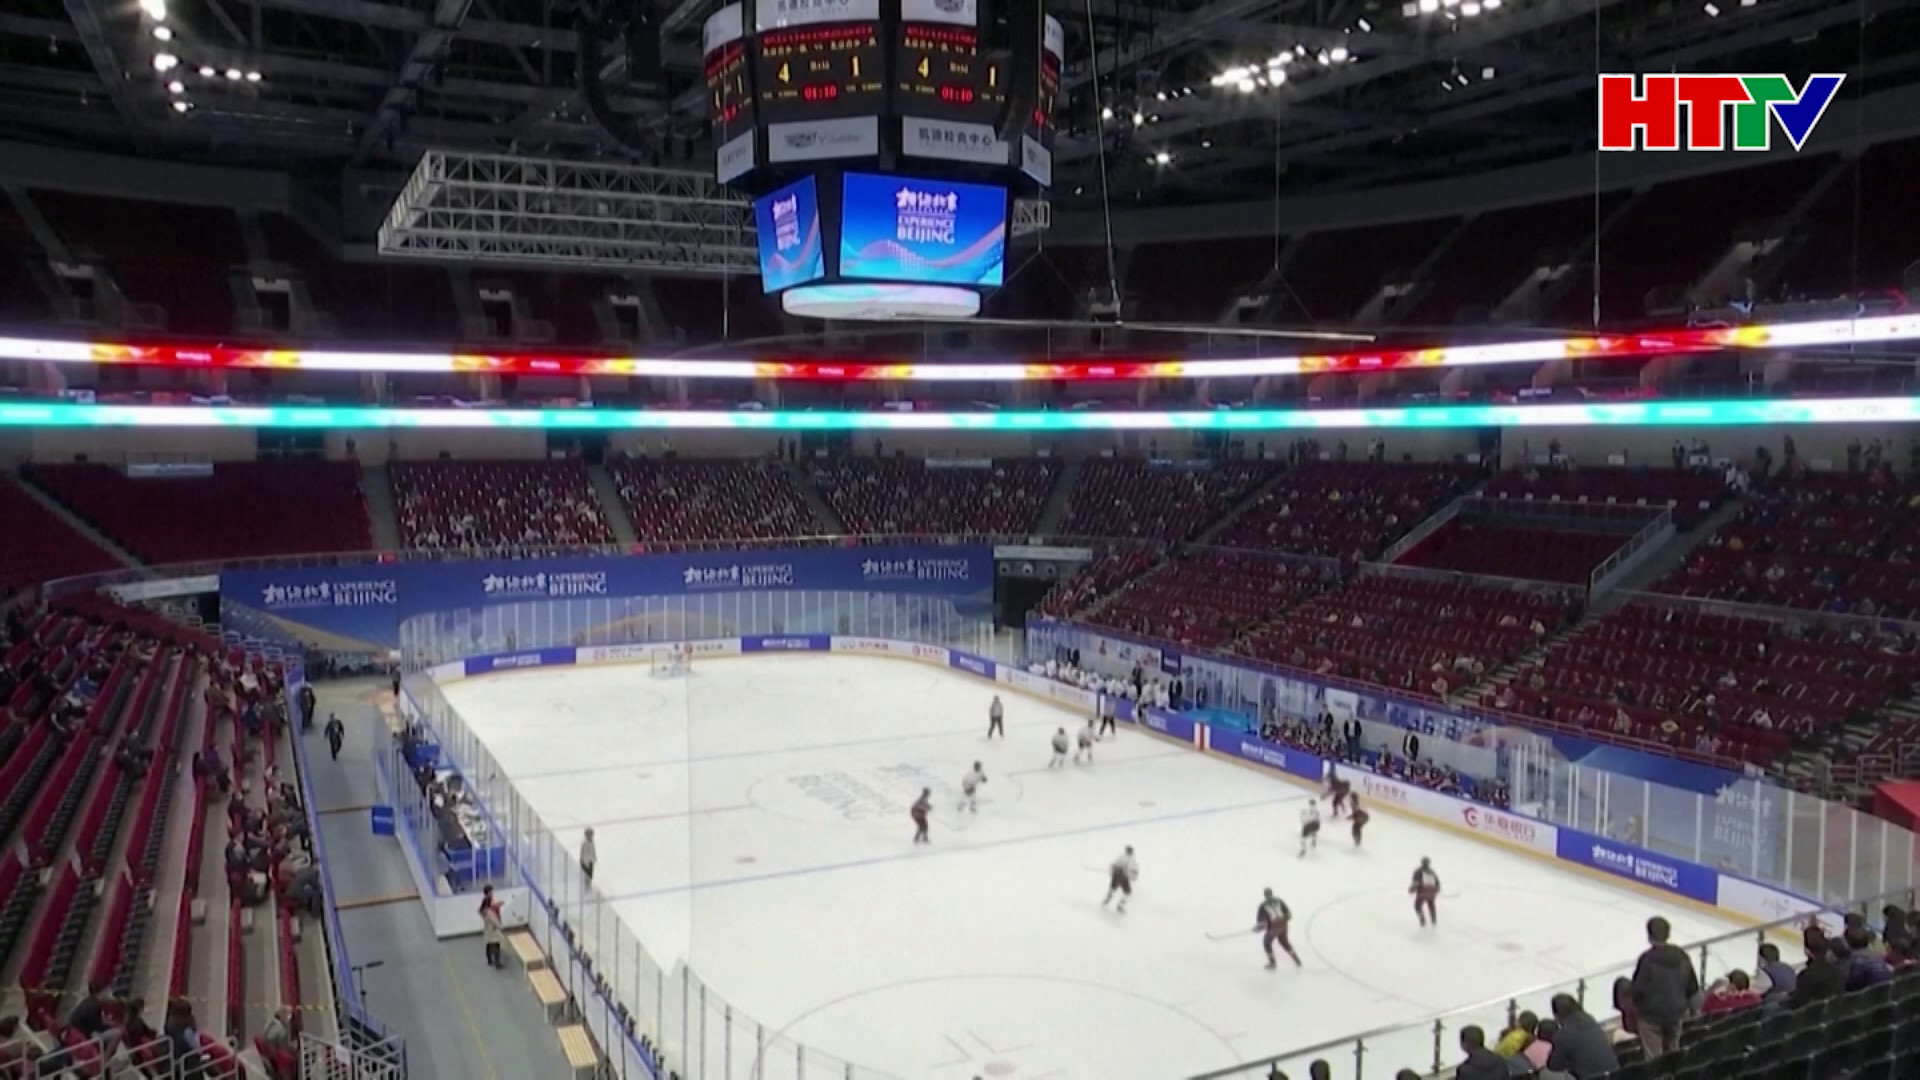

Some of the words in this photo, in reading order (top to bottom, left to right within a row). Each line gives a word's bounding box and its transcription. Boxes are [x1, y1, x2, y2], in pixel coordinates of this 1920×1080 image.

[777, 62, 791, 83] 4
[917, 56, 930, 78] 4
[804, 85, 837, 100] 01:10
[941, 86, 973, 101] 01:10
[897, 227, 955, 244] BEIJING
[742, 571, 793, 586] BEIJING
[917, 566, 968, 579] BEIJING
[549, 580, 607, 595] BEIJING
[334, 588, 397, 606] BEIJING
